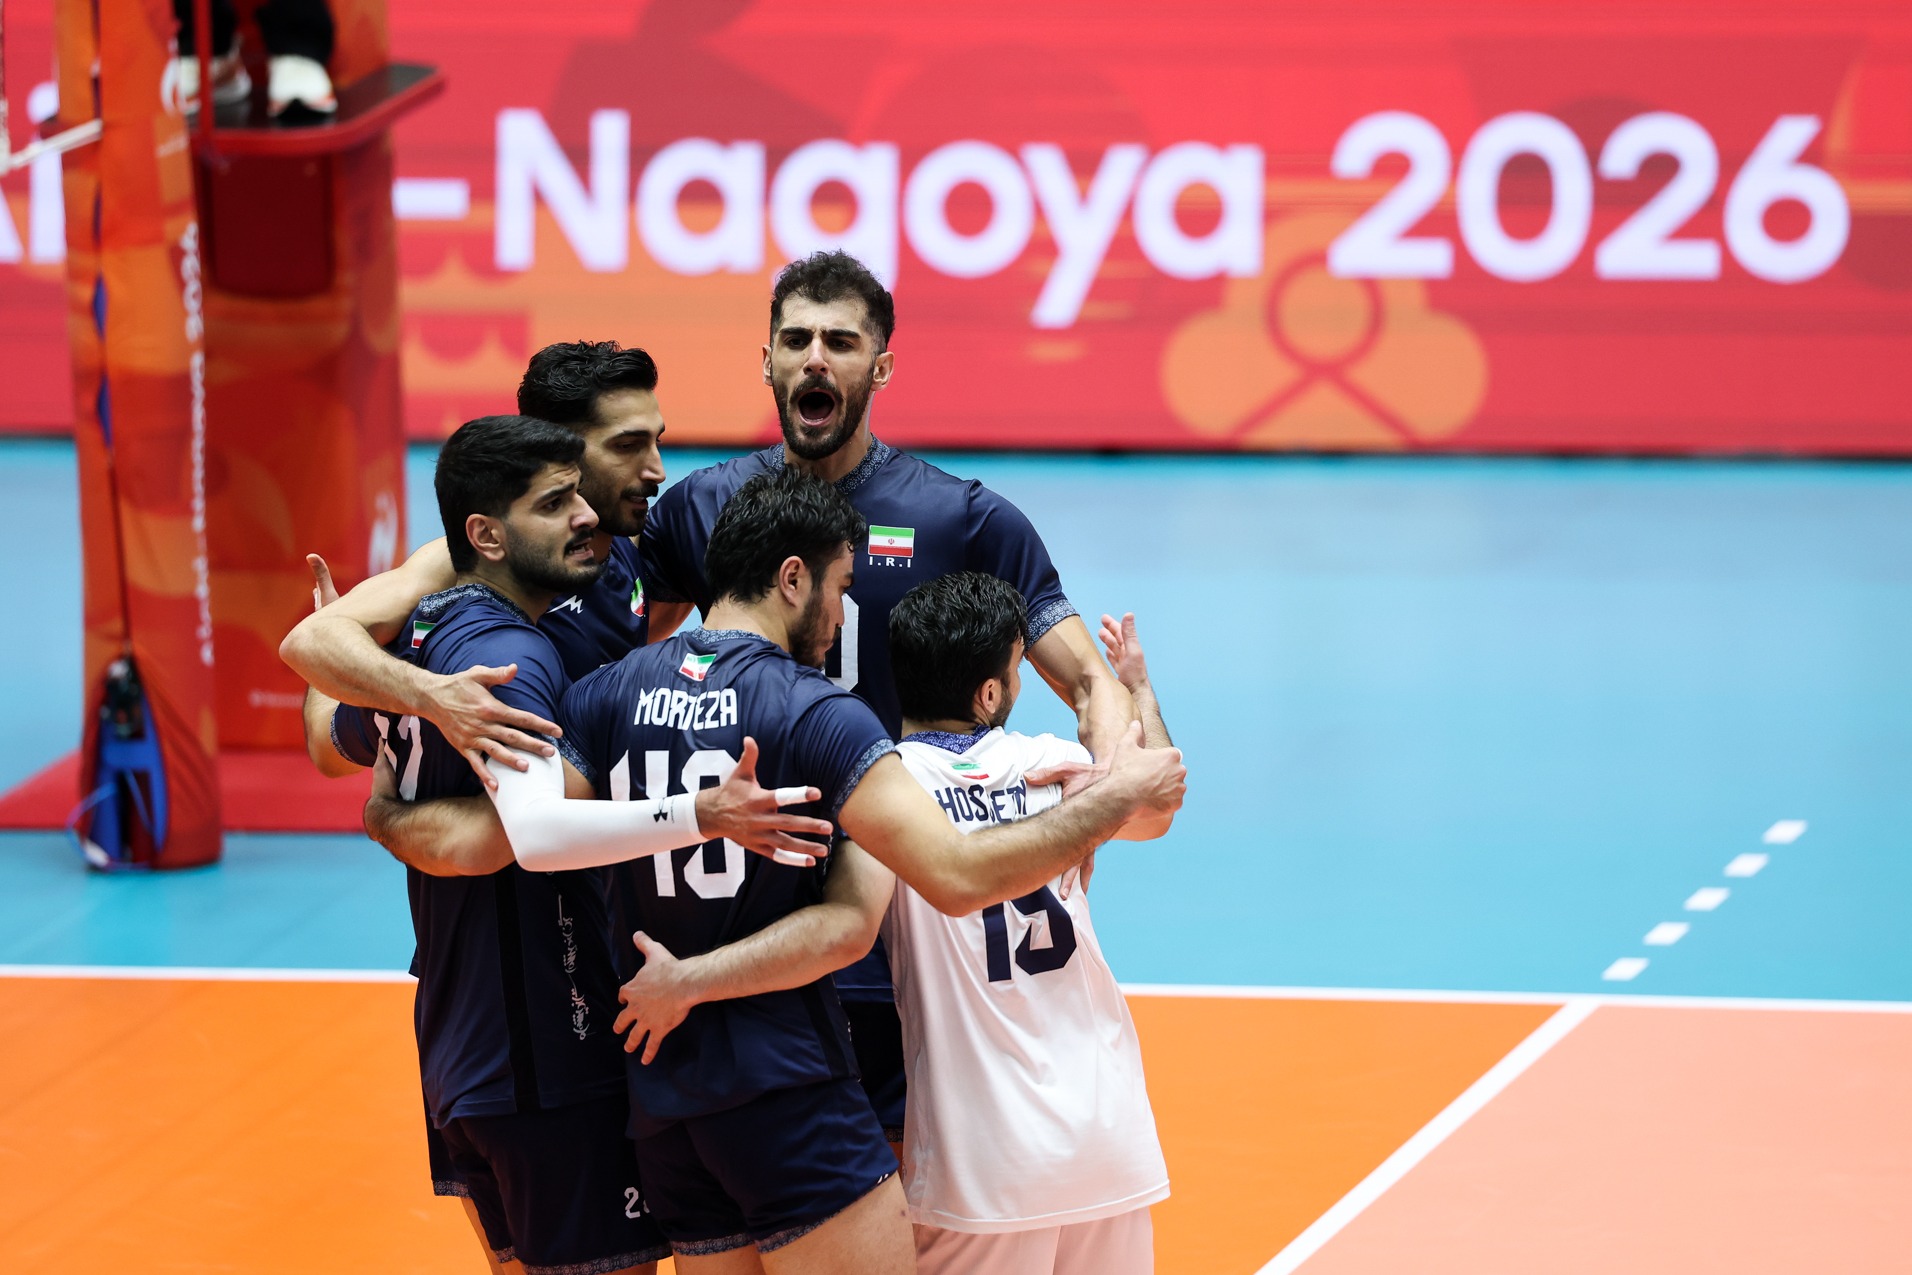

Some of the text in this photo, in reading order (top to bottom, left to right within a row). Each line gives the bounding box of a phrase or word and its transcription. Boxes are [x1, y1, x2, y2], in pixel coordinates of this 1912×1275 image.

[1327, 110, 1851, 284] 2026
[634, 687, 738, 731] MORTEZA
[935, 779, 1027, 824] HOSEN
[624, 1186, 650, 1219] 2
